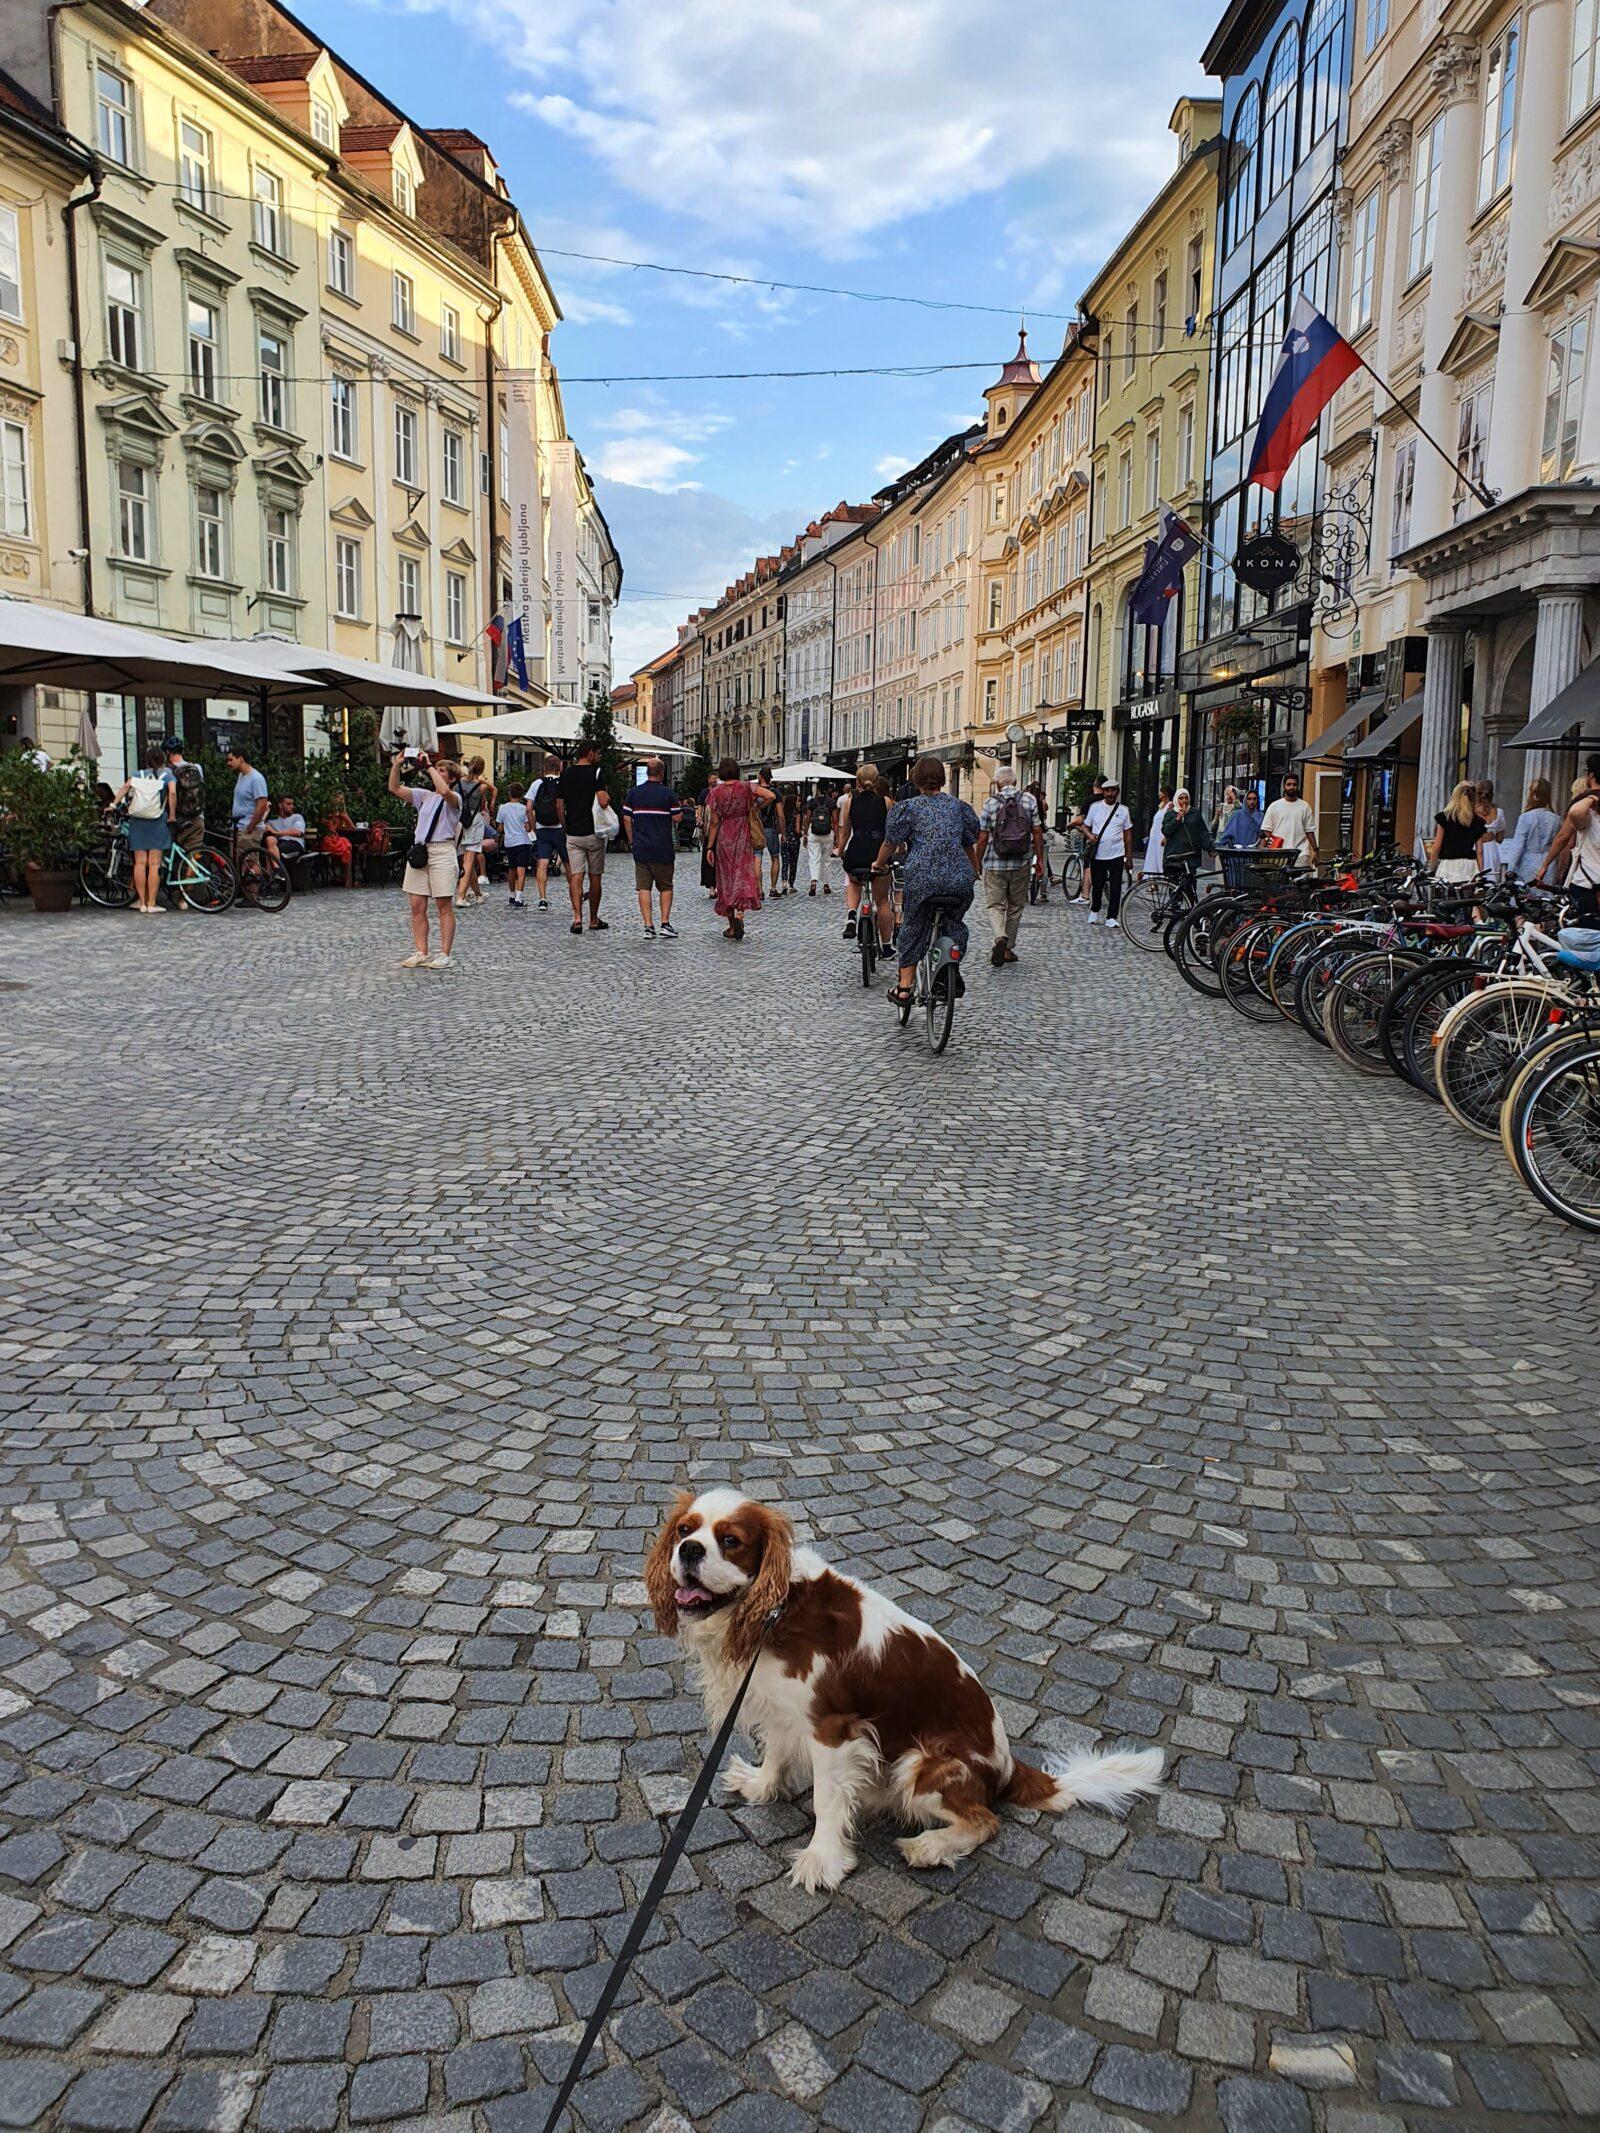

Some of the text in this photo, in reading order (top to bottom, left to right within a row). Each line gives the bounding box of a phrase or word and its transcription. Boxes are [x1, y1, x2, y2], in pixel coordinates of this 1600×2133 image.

[518, 504, 530, 555] Ljubljana
[519, 559, 531, 600] galerija
[1237, 559, 1298, 568] IKONA
